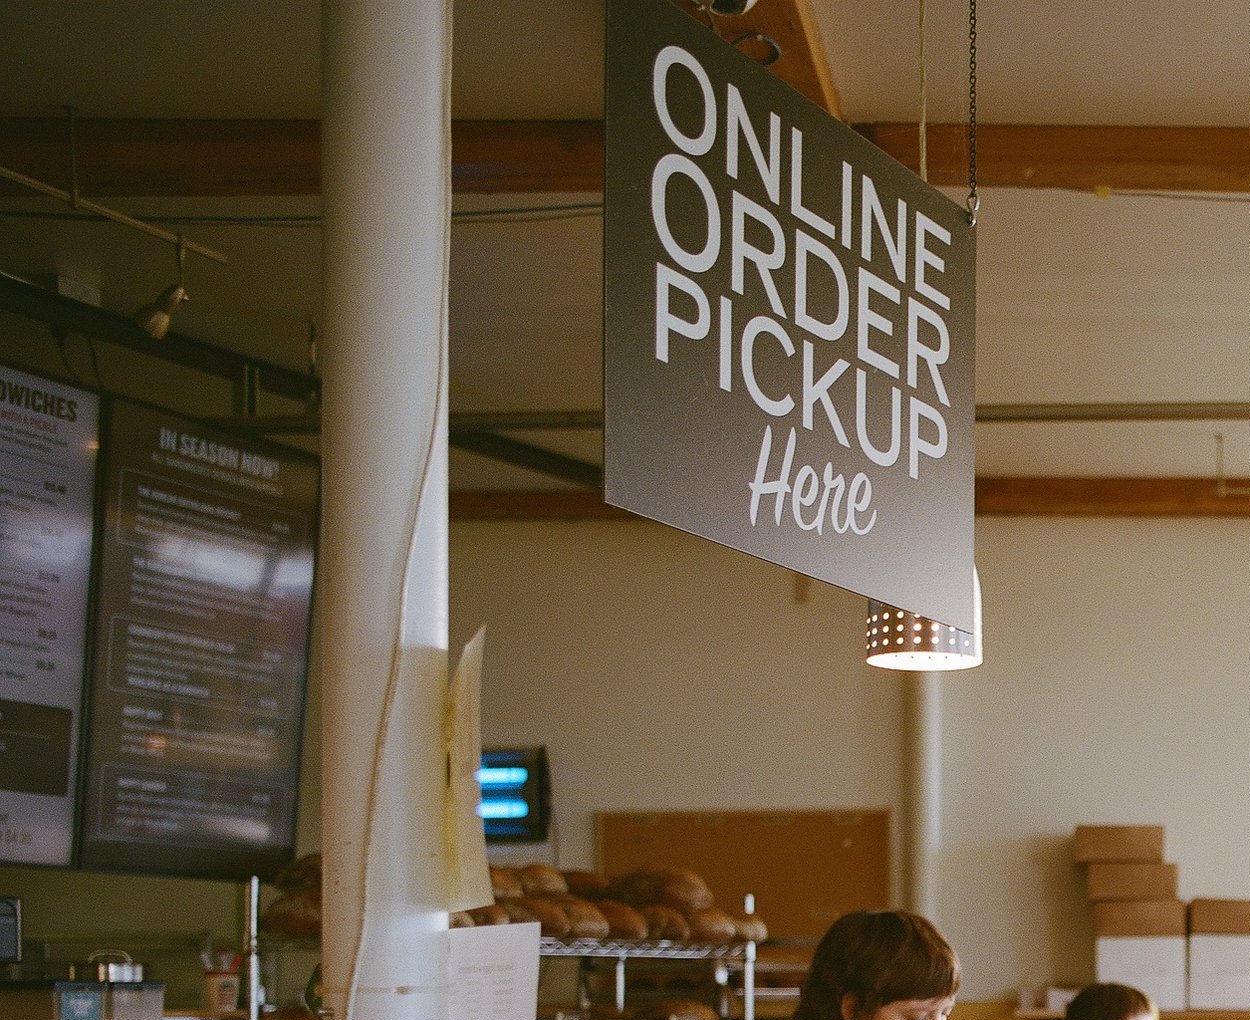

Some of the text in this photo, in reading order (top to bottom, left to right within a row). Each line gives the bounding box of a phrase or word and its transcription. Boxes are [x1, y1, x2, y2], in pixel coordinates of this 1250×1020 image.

[651, 153, 951, 408] ORDER
[653, 45, 952, 312] ONLINE
[159, 427, 177, 451] IN
[179, 433, 240, 469] SEASON
[655, 261, 949, 480] PICKUP
[748, 425, 878, 537] Here
